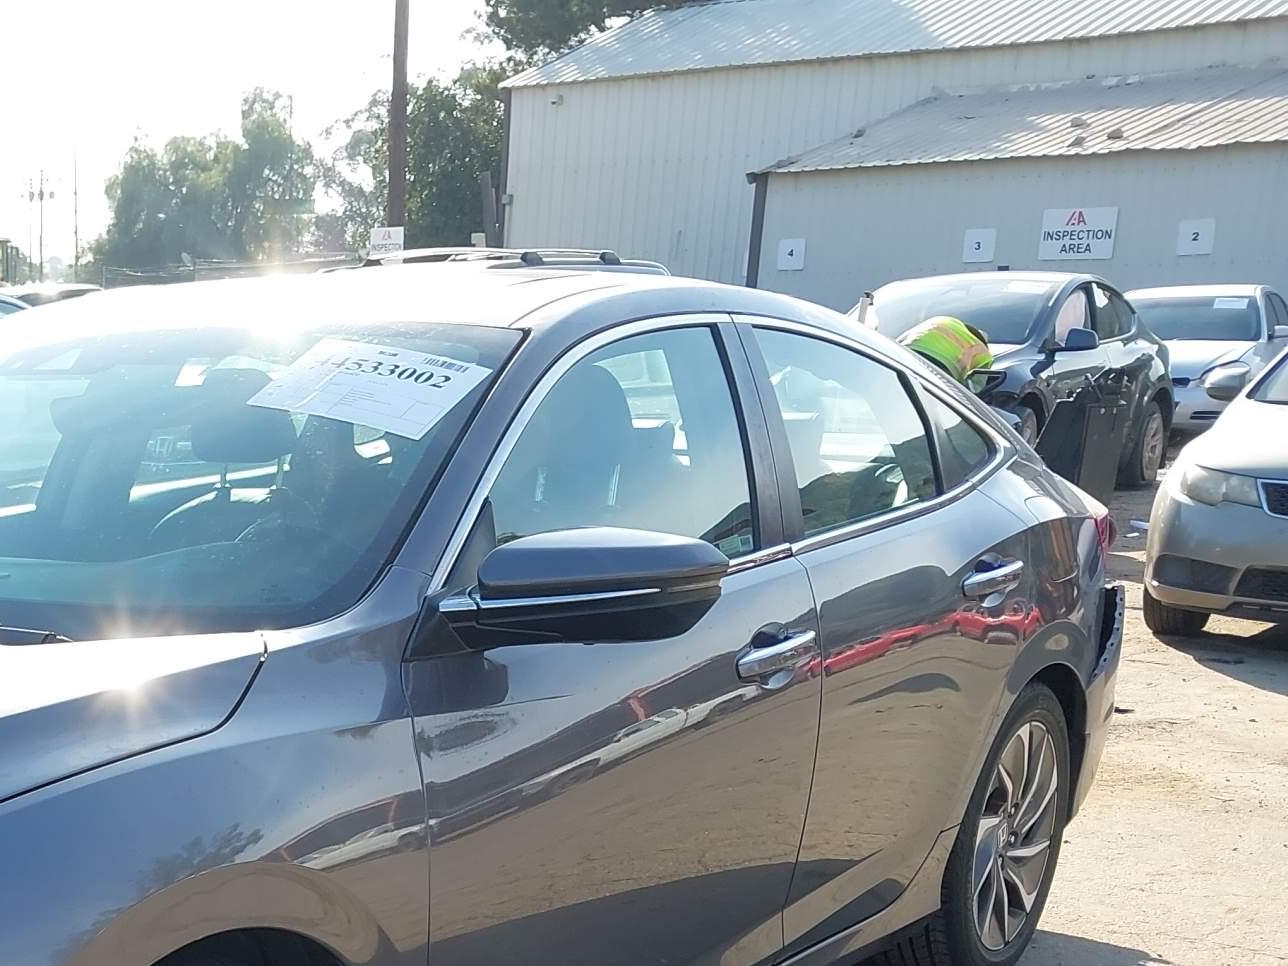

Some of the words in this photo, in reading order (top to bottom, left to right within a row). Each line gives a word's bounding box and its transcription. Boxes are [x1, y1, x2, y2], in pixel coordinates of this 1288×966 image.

[1043, 230, 1112, 242] INSPECTION
[1191, 232, 1200, 242] 2
[973, 241, 982, 251] 3
[1059, 243, 1091, 254] AREA
[787, 248, 795, 257] 4
